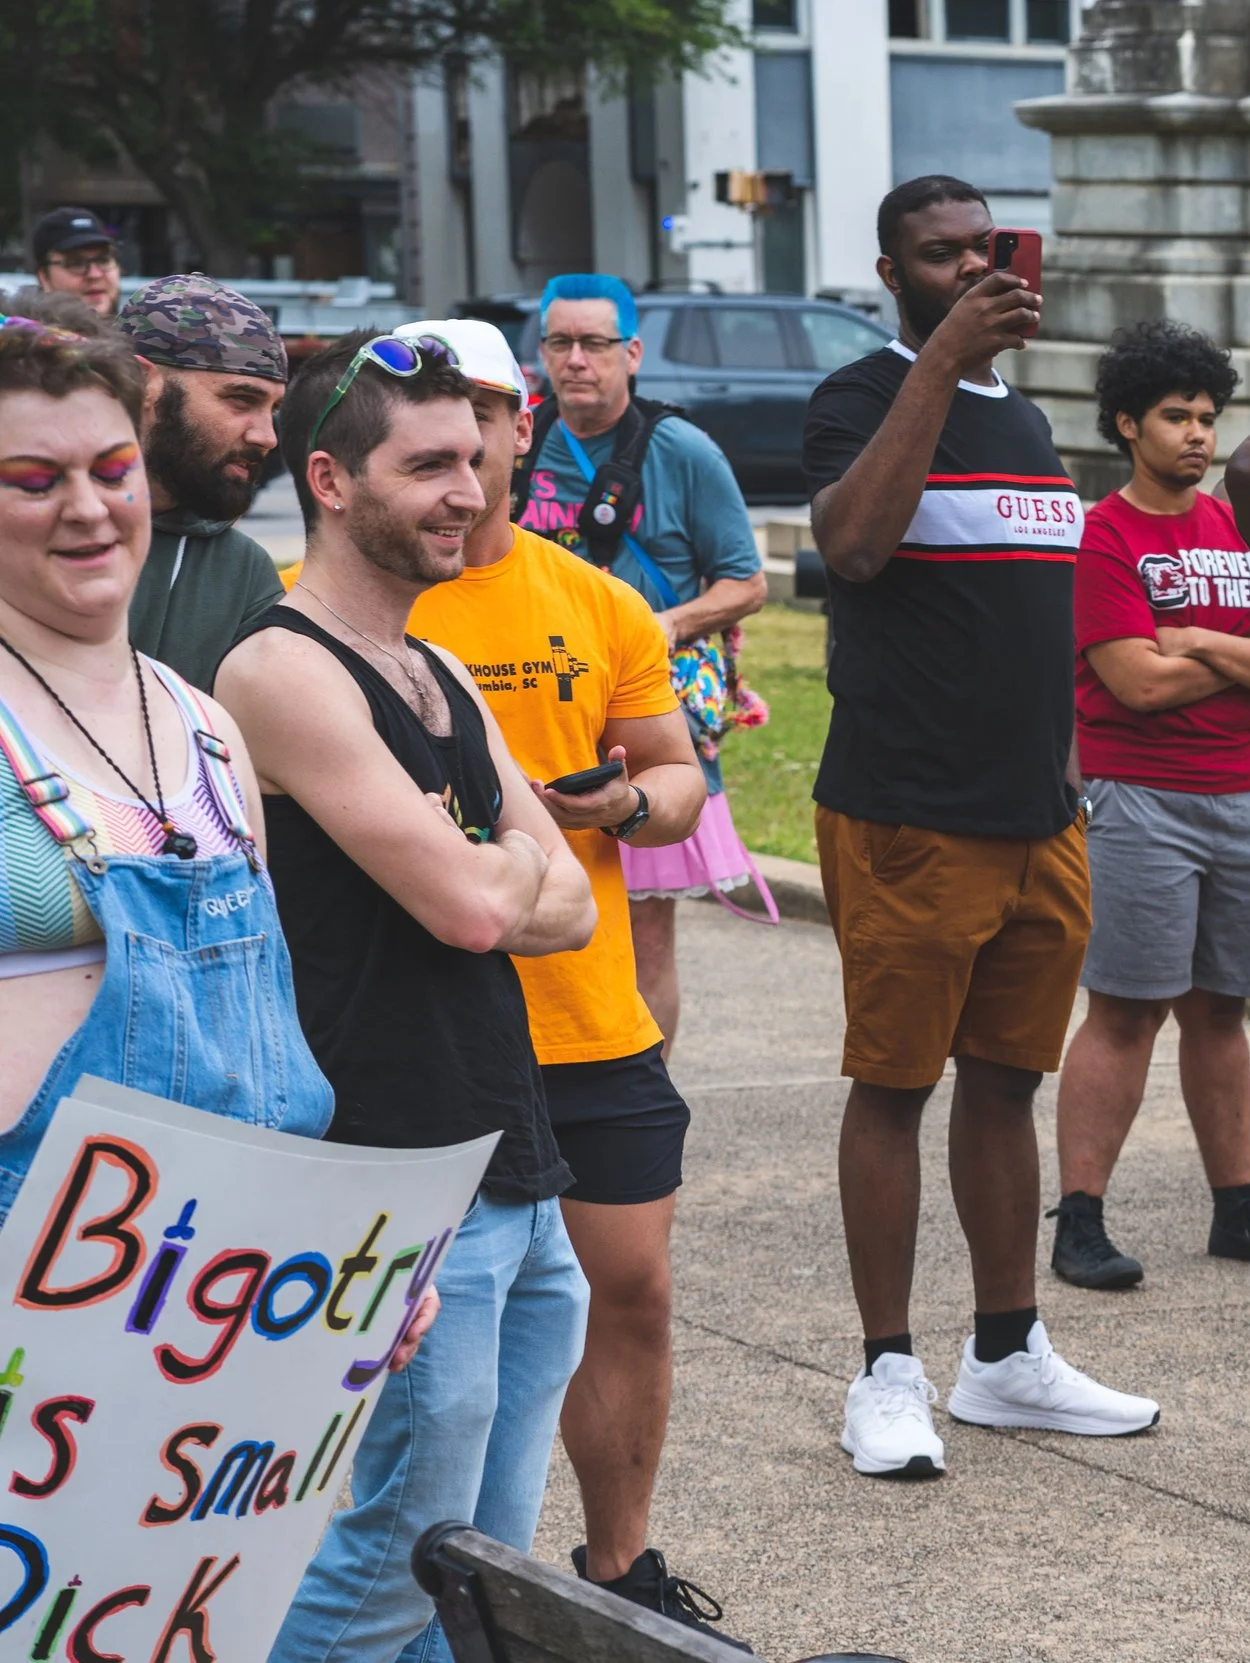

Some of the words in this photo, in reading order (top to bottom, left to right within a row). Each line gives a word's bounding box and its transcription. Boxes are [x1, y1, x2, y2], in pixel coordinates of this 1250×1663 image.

[997, 495, 1076, 524] GUESS
[1014, 525, 1028, 534] LOS
[1032, 527, 1065, 537] ANGELES
[1185, 576, 1210, 607] TO
[464, 663, 517, 677] KHOUSE
[522, 661, 554, 674] GYM
[475, 680, 517, 692] umbia,
[522, 677, 538, 689] SC
[13, 1133, 453, 1392] Bigotry
[138, 1396, 367, 1529] Small
